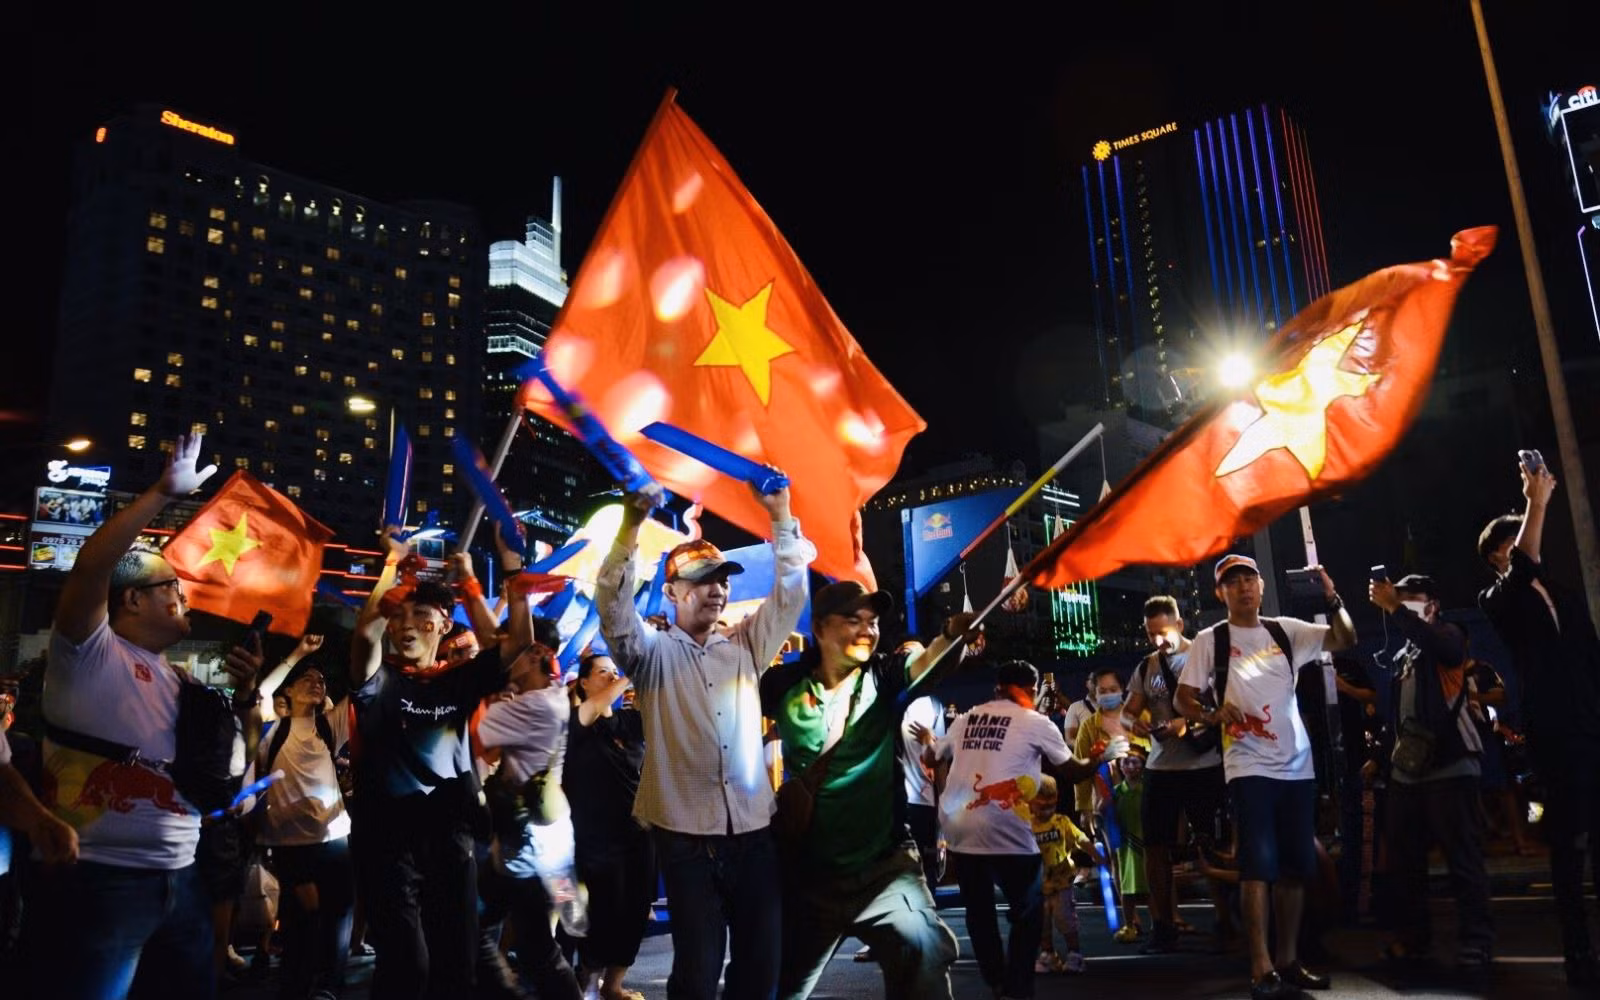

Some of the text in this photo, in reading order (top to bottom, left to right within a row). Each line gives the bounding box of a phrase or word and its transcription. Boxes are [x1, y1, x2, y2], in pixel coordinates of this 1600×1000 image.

[160, 110, 235, 145] Sheraton
[1113, 121, 1178, 151] TIMES SQUARE
[401, 698, 457, 720] Champion
